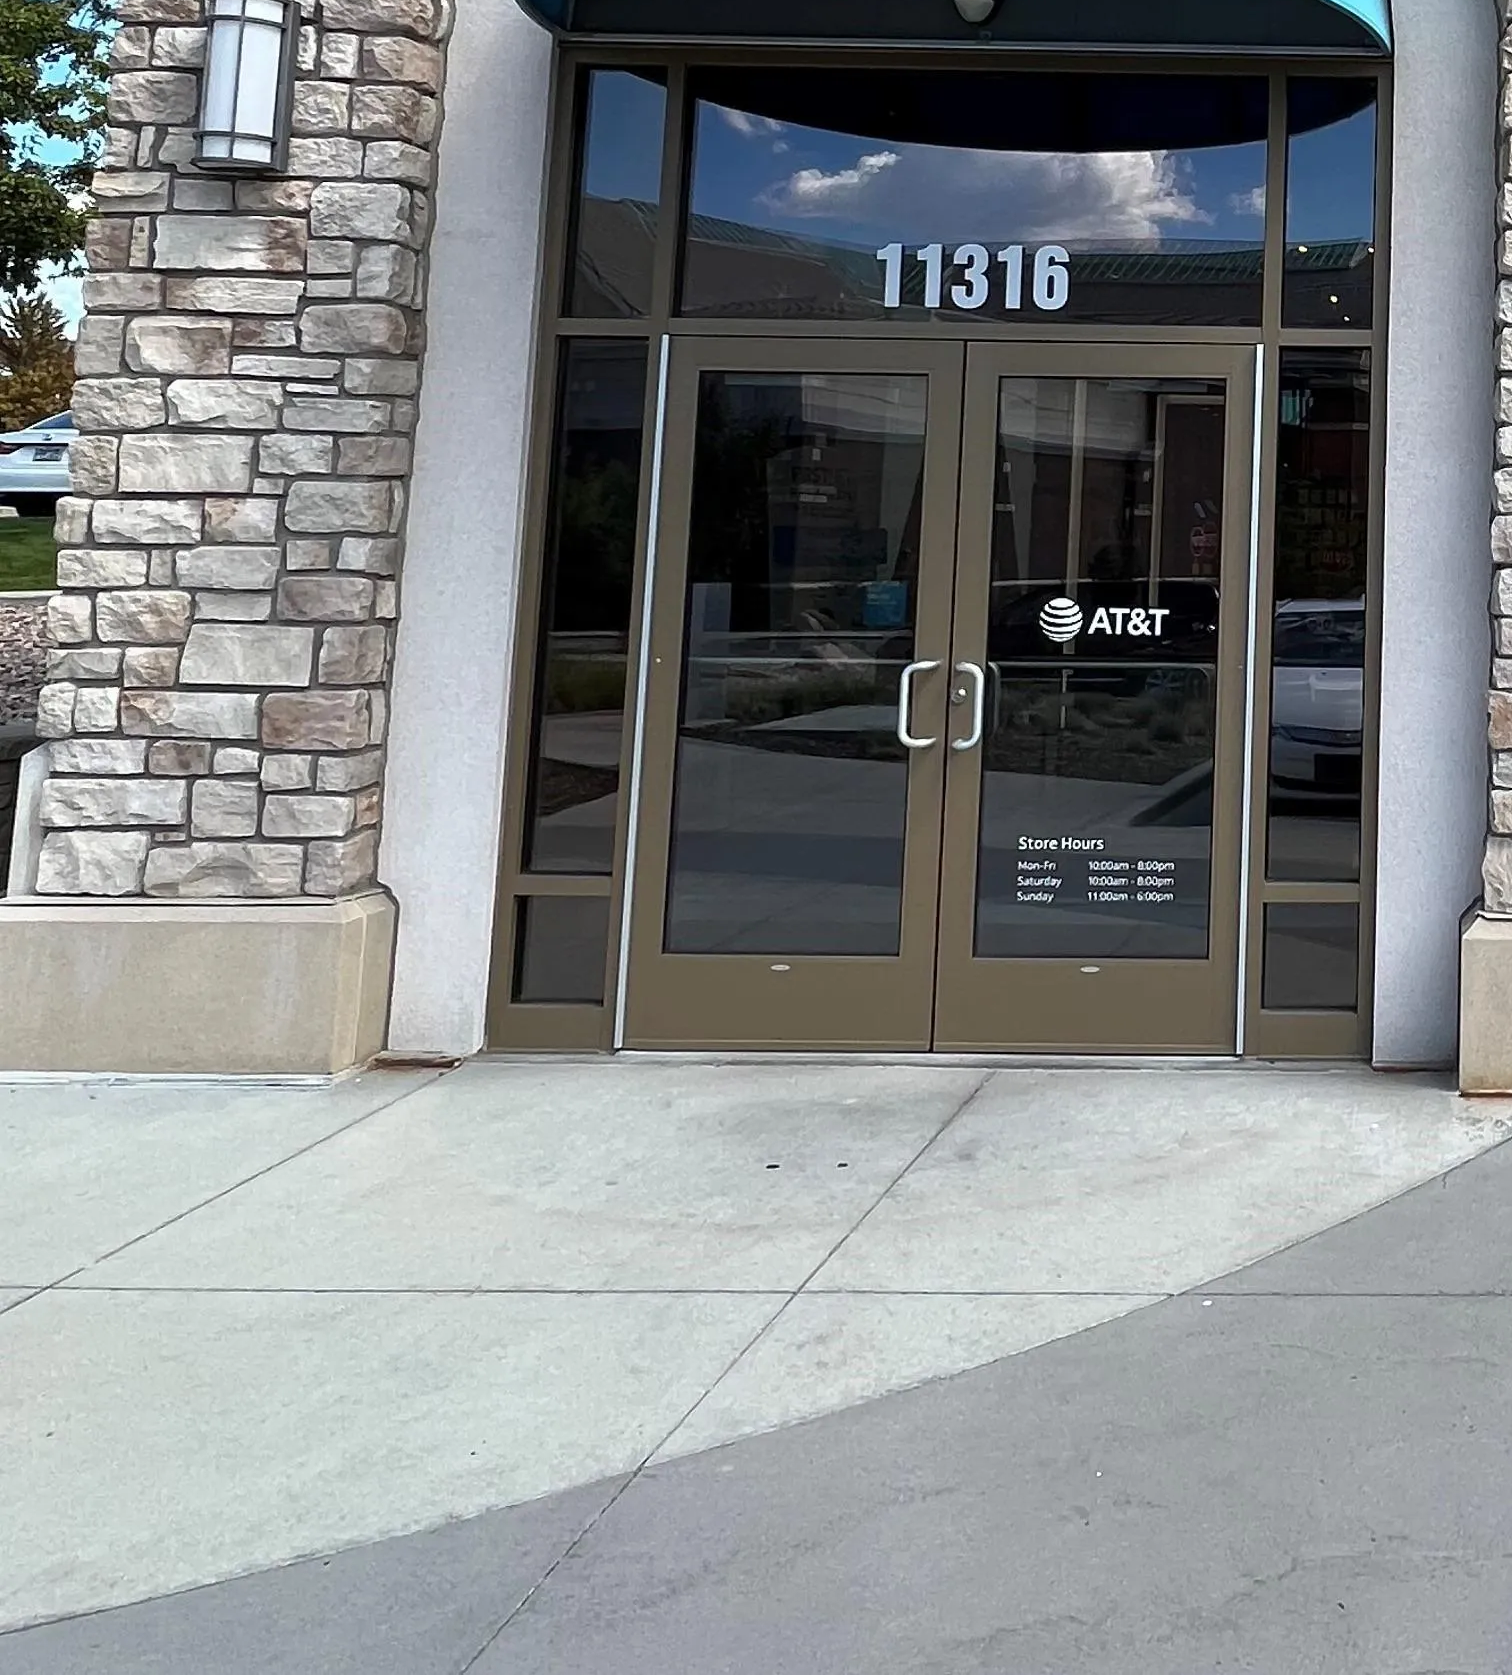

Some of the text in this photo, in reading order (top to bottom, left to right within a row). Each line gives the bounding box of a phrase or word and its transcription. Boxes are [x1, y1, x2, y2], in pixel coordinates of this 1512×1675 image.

[876, 243, 1071, 310] 11316
[1087, 607, 1170, 636] AT&T
[1017, 836, 1104, 850] Store Hours
[1017, 861, 1057, 871] Mon-Fri
[1088, 861, 1129, 871] 10:00am
[1137, 861, 1175, 873] 8:00pm
[1017, 876, 1062, 888] Saturday
[1088, 877, 1129, 886] 10:00am
[1137, 876, 1174, 888] 8:00pm
[1017, 891, 1054, 903] Sunday
[1087, 892, 1129, 902] 11:00am
[1137, 891, 1174, 902] 6:00pm
